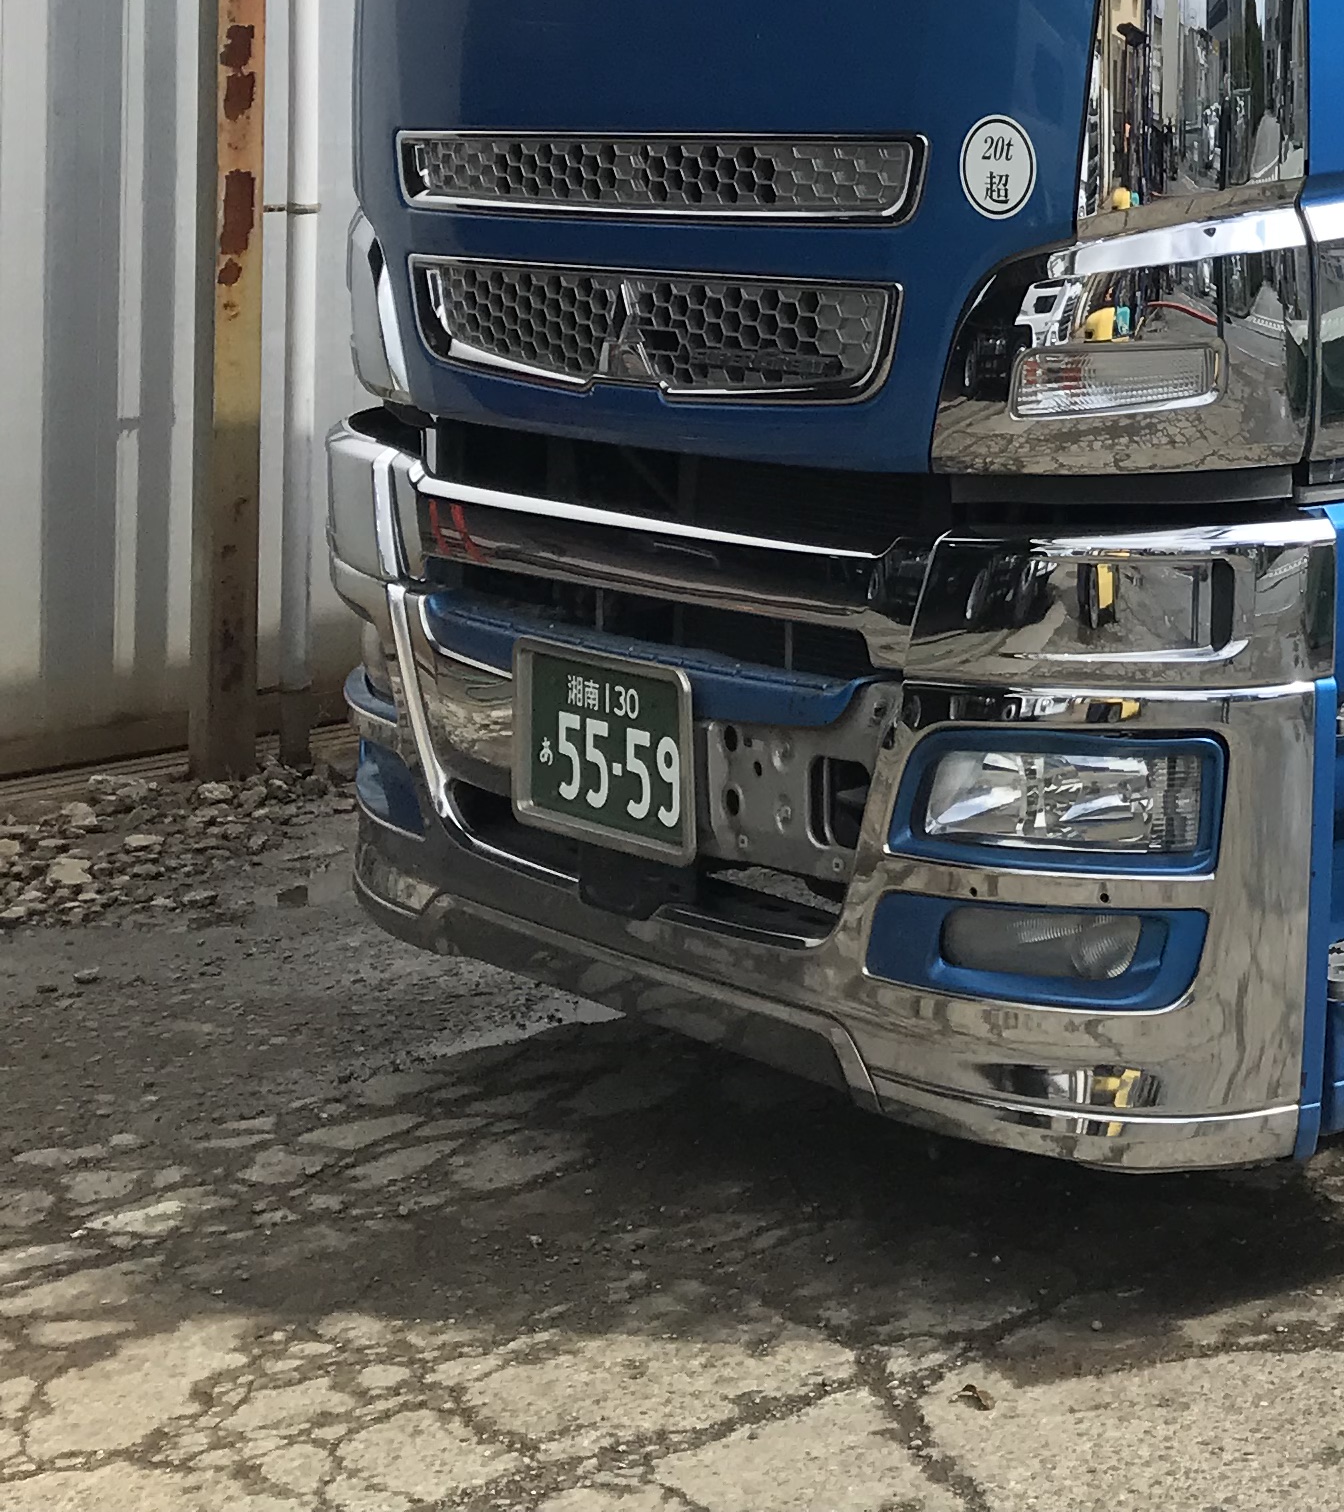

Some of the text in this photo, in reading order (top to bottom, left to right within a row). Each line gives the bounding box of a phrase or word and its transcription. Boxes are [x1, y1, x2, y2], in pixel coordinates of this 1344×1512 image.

[981, 135, 1014, 161] 20t
[984, 170, 1010, 204] 超
[539, 710, 681, 828] あ 55-59
